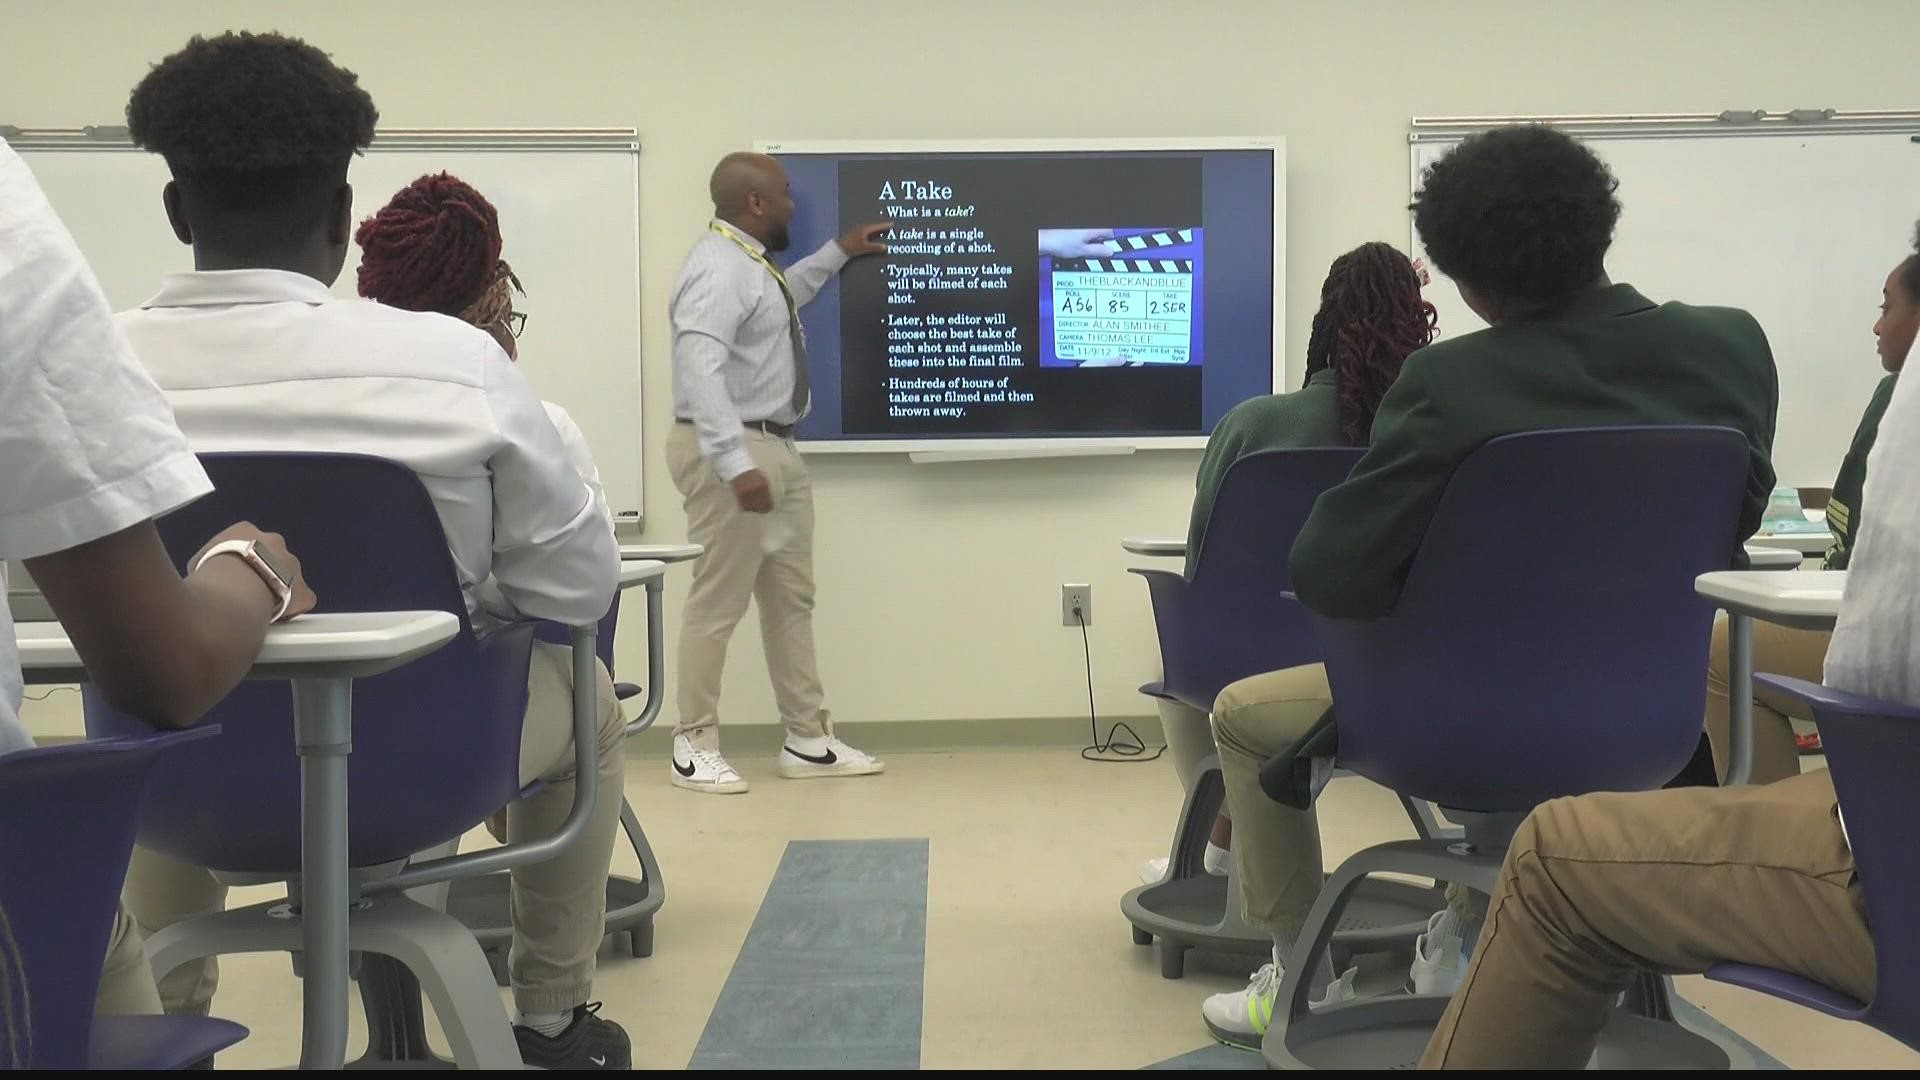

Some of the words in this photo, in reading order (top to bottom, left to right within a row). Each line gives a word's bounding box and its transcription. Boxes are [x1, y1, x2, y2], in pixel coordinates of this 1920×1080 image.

[879, 181, 896, 200] A
[901, 181, 952, 200] Take
[887, 206, 918, 217] What
[921, 206, 931, 217] is
[935, 209, 941, 217] a
[945, 205, 974, 217] take?
[887, 229, 896, 239] A
[899, 229, 923, 239] take
[926, 229, 936, 239] is
[940, 231, 946, 239] a
[950, 228, 983, 241] single
[887, 243, 941, 255] recording
[944, 243, 955, 253] of
[958, 245, 964, 253] a
[968, 243, 995, 253] shot.
[887, 265, 943, 278] Typically,
[947, 267, 979, 277] many
[981, 264, 1012, 274] takes
[888, 279, 909, 290] will
[913, 279, 925, 290] be
[928, 278, 964, 289] filmed
[968, 278, 978, 289] of
[981, 278, 1007, 289] each
[1079, 276, 1186, 288] THEBLACKANDBLUE
[888, 292, 915, 303] shot.
[1108, 300, 1129, 313] 85
[1150, 301, 1159, 314] 2
[1162, 302, 1186, 314] SER
[888, 314, 923, 327] Later,
[926, 314, 945, 325] the
[948, 313, 982, 325] editor
[985, 313, 1006, 324] will
[1093, 320, 1119, 329] ALAN
[1124, 322, 1170, 331] SMITHEE
[888, 328, 925, 339] choose
[928, 328, 947, 339] the
[950, 328, 973, 338] best
[977, 328, 1002, 338] take
[1005, 327, 1017, 338] of
[1087, 334, 1131, 343] THOMAS
[1134, 335, 1153, 344] LEE
[888, 342, 915, 353] each
[918, 342, 942, 353] shot
[945, 342, 967, 352] and
[969, 341, 1022, 352] assemble
[1078, 348, 1111, 356] 11/9/12
[889, 356, 919, 367] these
[922, 356, 945, 367] into
[948, 356, 967, 367] the
[969, 356, 995, 366] final
[998, 355, 1024, 366] film.
[889, 378, 945, 389] Hundreds
[948, 378, 960, 388] of
[962, 378, 994, 388] hours
[997, 377, 1008, 388] of
[889, 392, 920, 402] takes
[923, 394, 942, 402] are
[944, 391, 980, 402] filmed
[983, 391, 1005, 402] and
[1008, 391, 1034, 401] then
[889, 405, 930, 416] thrown
[933, 407, 966, 418] away.
